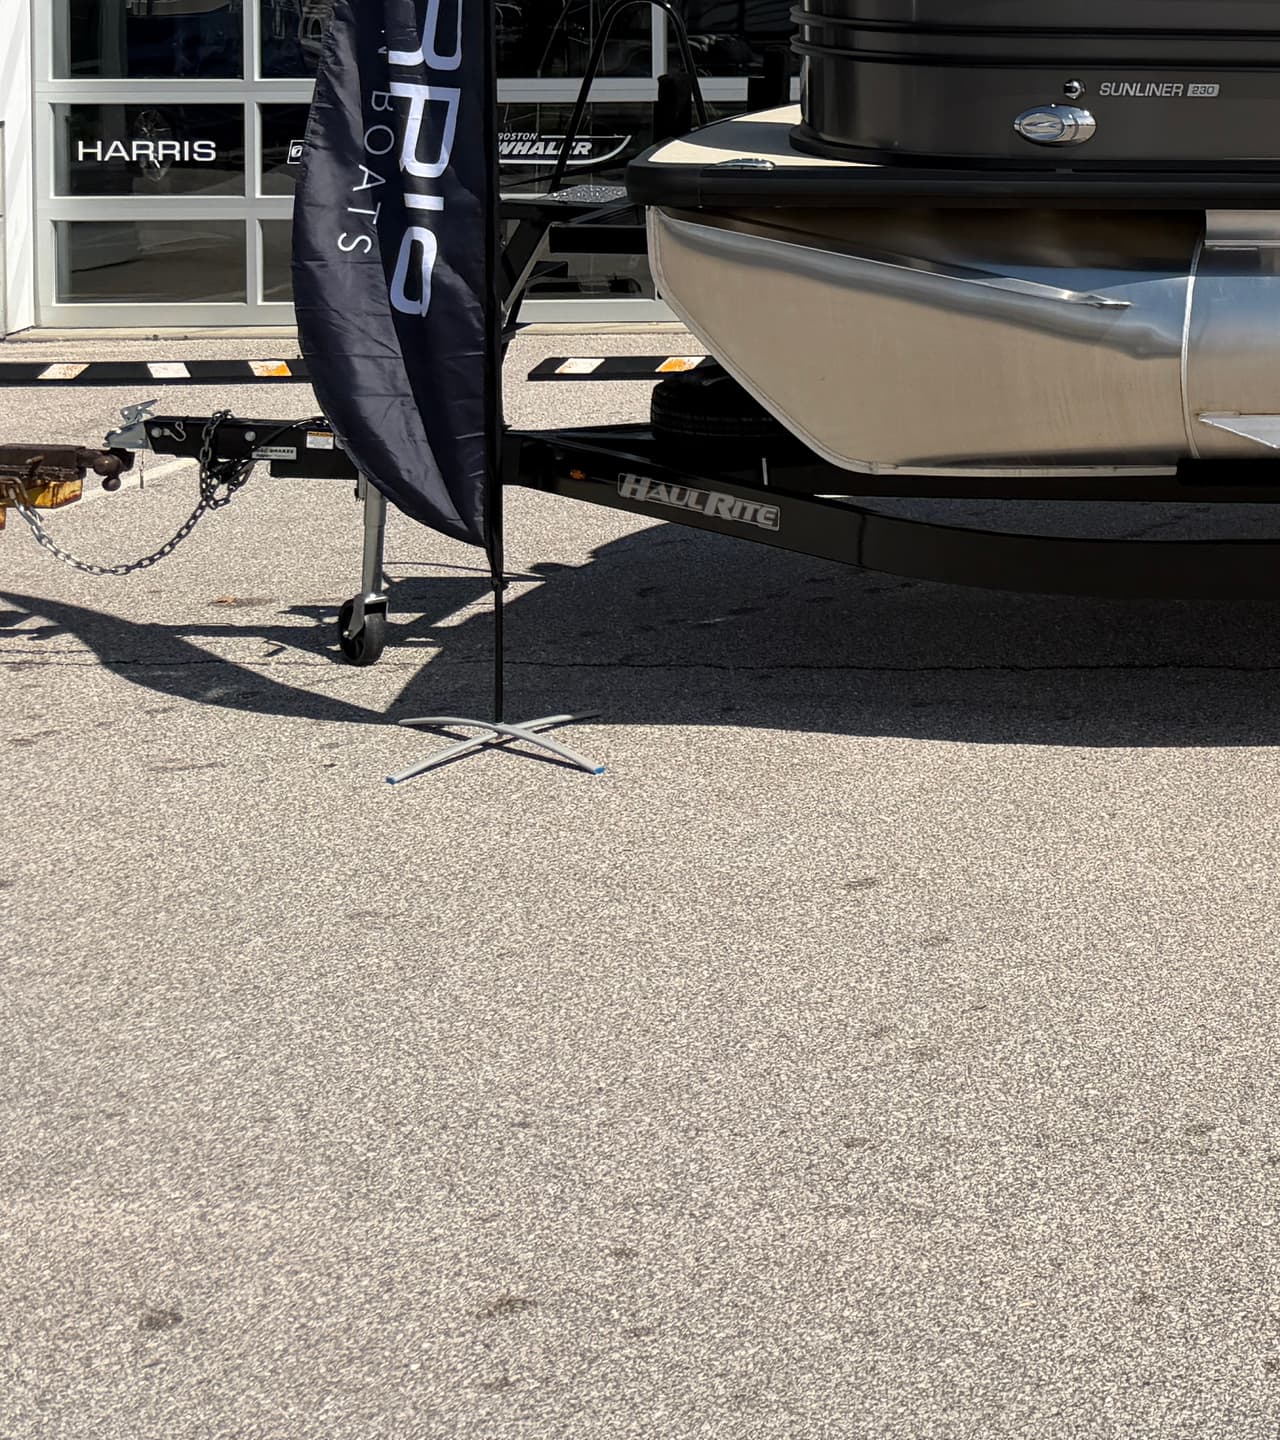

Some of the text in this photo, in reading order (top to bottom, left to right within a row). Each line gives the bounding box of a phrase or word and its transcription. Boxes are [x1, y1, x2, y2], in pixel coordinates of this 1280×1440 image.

[1099, 82, 1184, 97] SUNLINER
[78, 140, 217, 162] HARRIS
[499, 141, 593, 155] WHALR
[337, 90, 395, 255] BOATS
